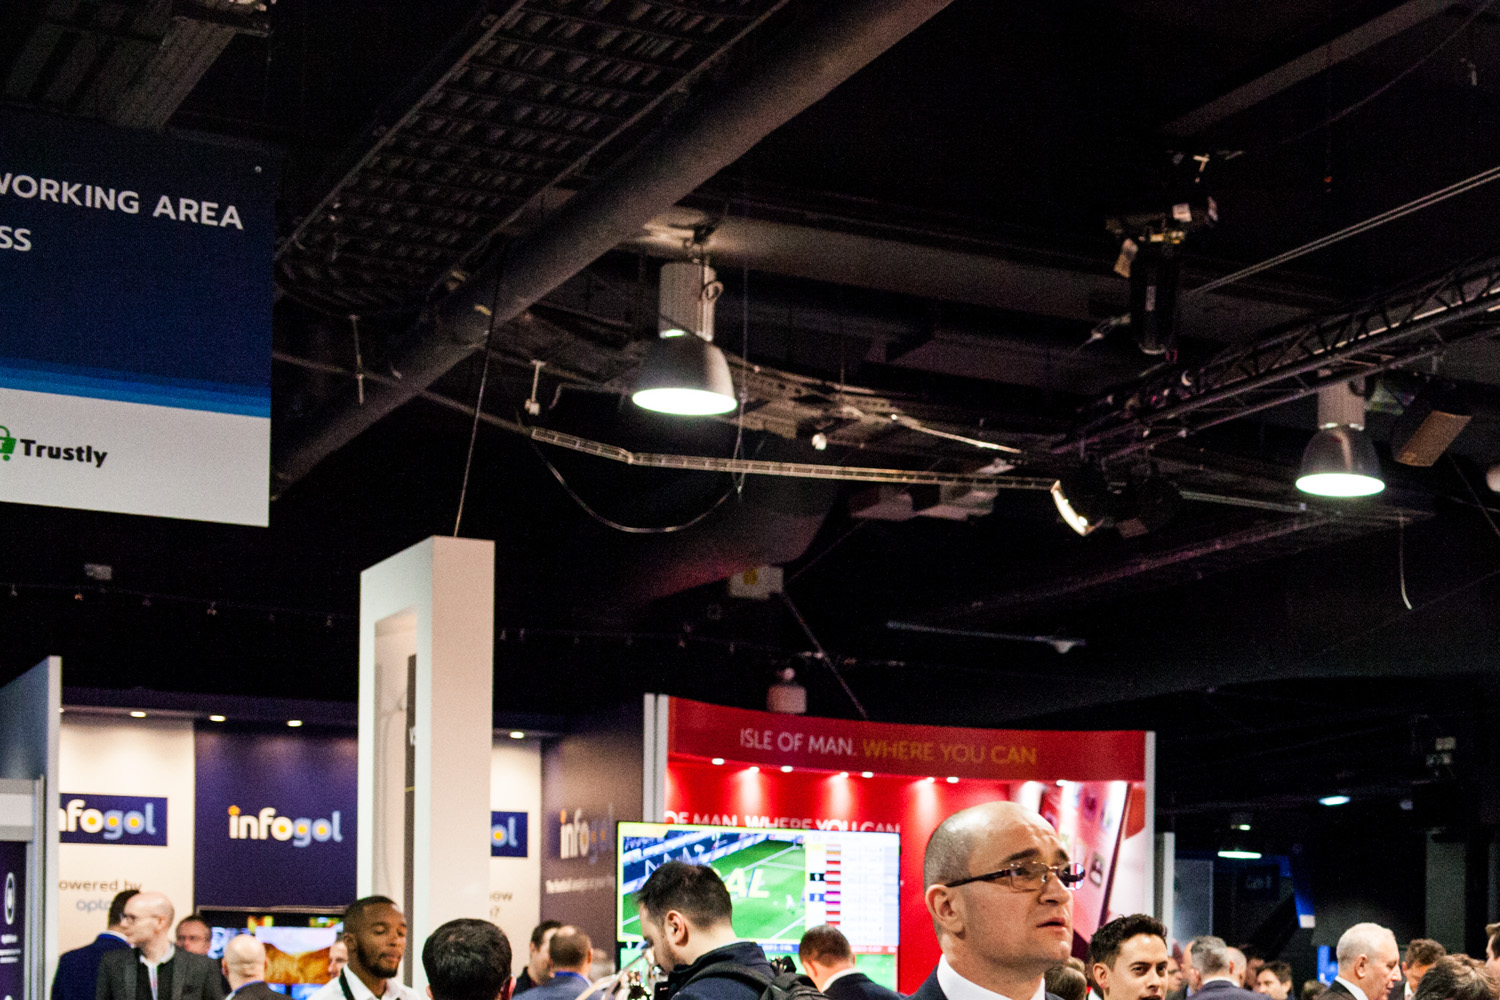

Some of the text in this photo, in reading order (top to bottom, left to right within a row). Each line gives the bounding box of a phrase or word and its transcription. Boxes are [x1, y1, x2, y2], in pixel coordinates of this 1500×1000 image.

[152, 195, 243, 231] AREA
[19, 438, 108, 468] Trustly
[740, 727, 772, 750] ISLE
[777, 731, 804, 752] OF
[862, 738, 935, 761] WHERE
[939, 742, 986, 764] YOU
[989, 745, 1037, 766] CAN
[227, 804, 343, 848] infogol
